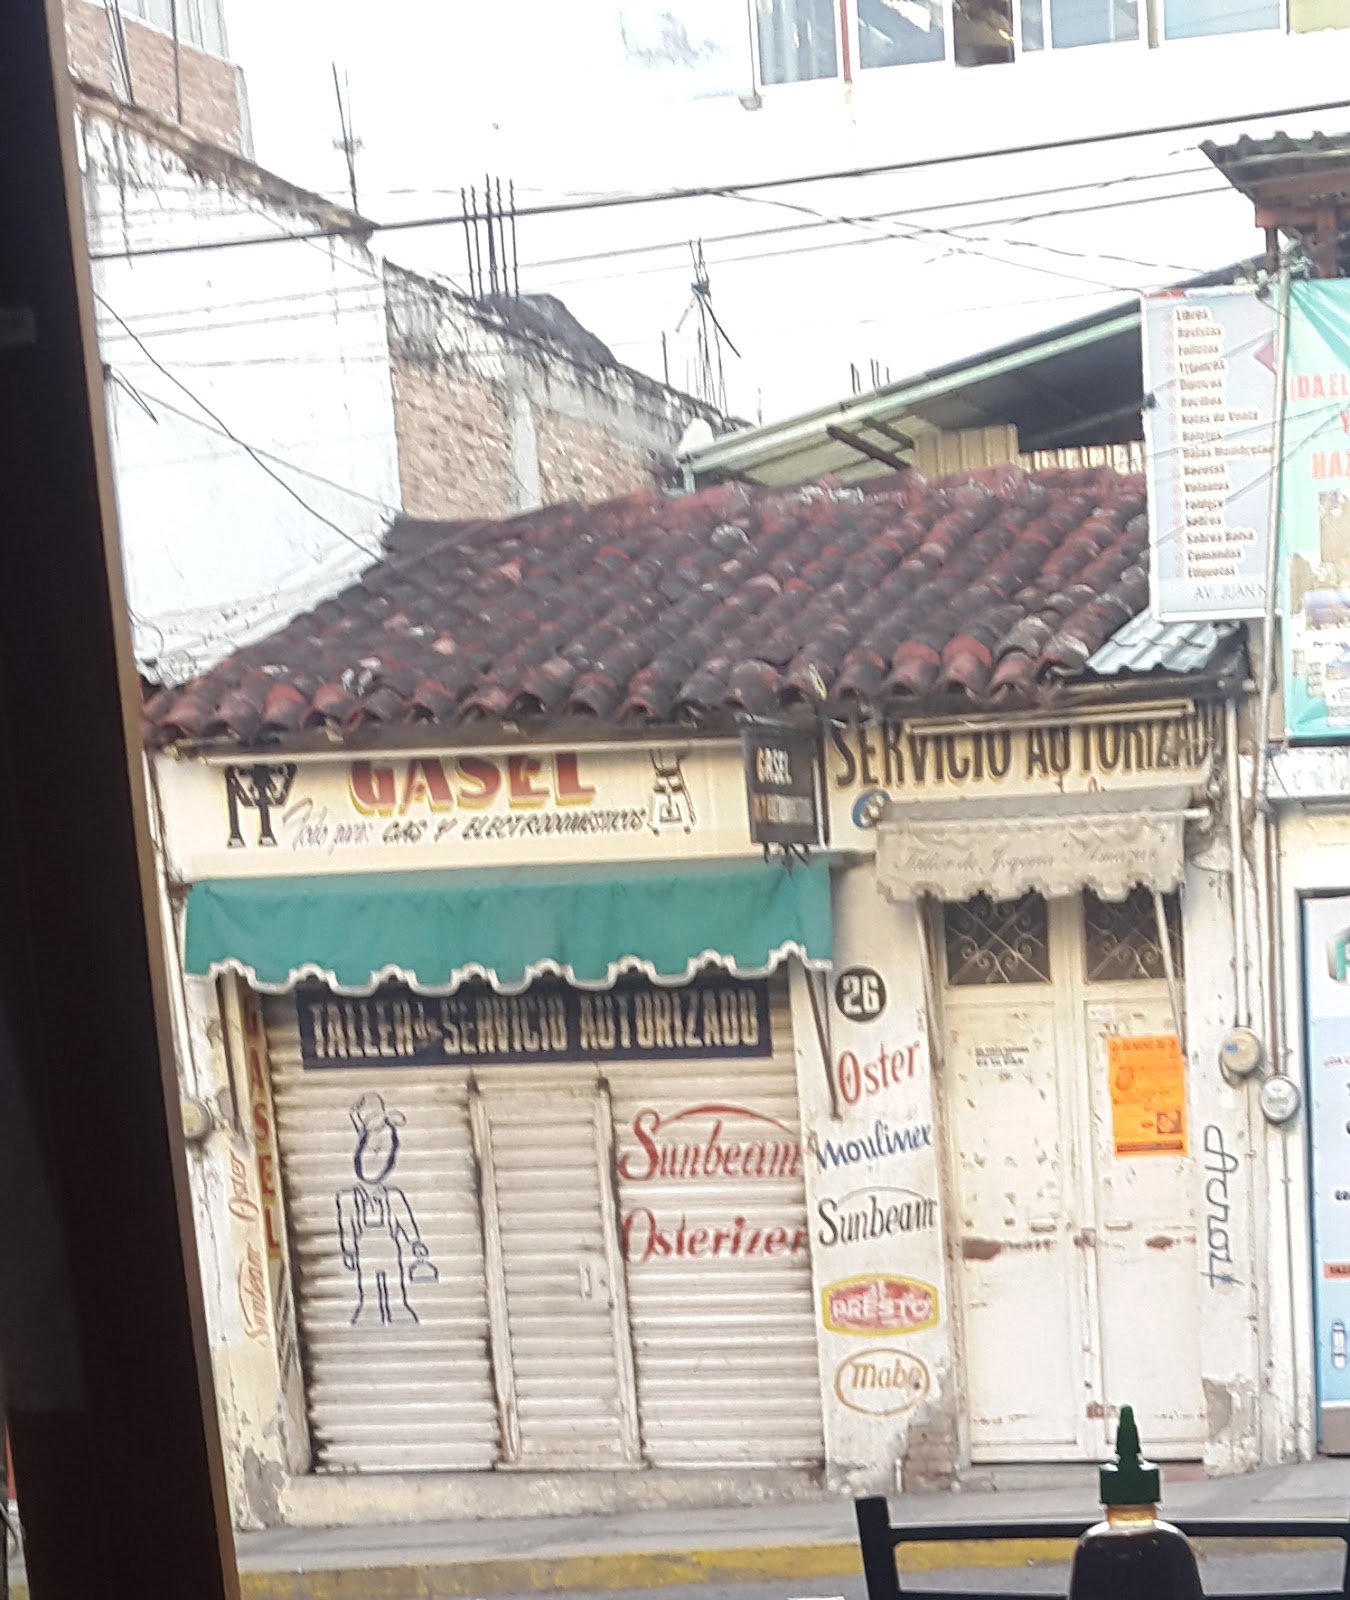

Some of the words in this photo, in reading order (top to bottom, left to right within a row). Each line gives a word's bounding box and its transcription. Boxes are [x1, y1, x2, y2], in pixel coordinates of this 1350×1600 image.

[1329, 371, 1348, 398] EL
[1339, 410, 1350, 434] Y
[830, 723, 1013, 788] SERVICIO
[1027, 708, 1216, 780] AUTORIZAD
[349, 753, 597, 817] GASEL
[434, 817, 458, 844] Y
[312, 1001, 415, 1059] TALLER
[441, 995, 568, 1056] SERVICIO
[580, 988, 759, 1050] AUTORIZADO
[842, 974, 879, 1014] 26
[838, 1040, 922, 1105] Oster
[618, 1106, 803, 1182] Sunbeam
[228, 1149, 260, 1223] Oster
[623, 1206, 810, 1264] Osterizer
[817, 1187, 939, 1248] Sunbeam
[831, 1298, 931, 1326] PRESTO
